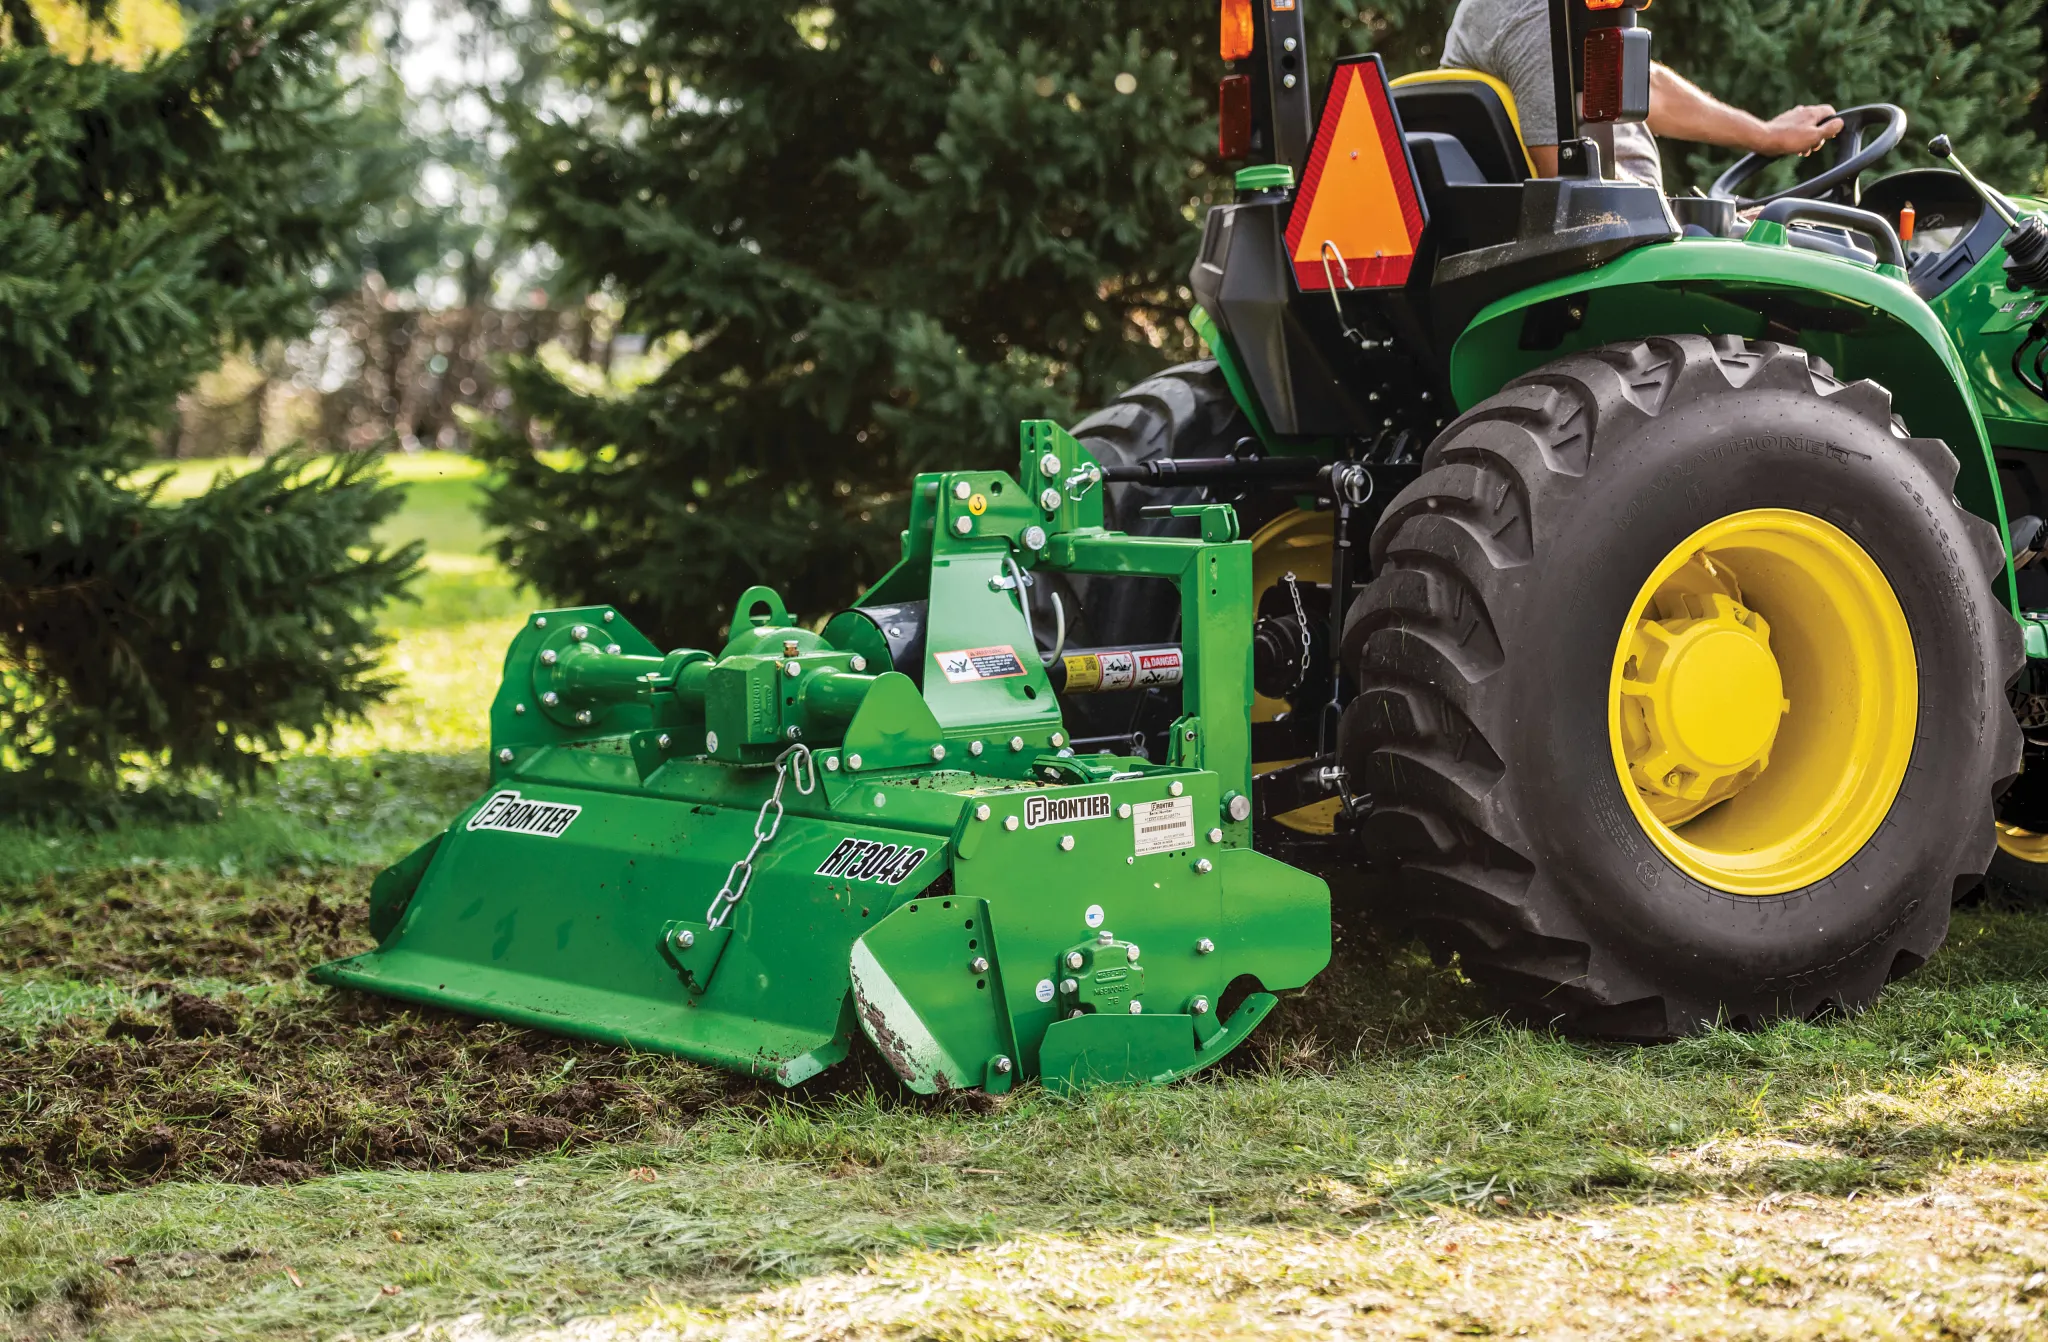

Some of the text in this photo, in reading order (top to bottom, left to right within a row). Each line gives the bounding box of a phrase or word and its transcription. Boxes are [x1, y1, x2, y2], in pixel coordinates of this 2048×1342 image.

[1150, 655, 1179, 667] DANGER
[470, 793, 579, 834] FRONTIER
[1026, 795, 1110, 826] FRONTIER
[1151, 802, 1174, 811] FRONTIER
[815, 838, 927, 885] RT3049
